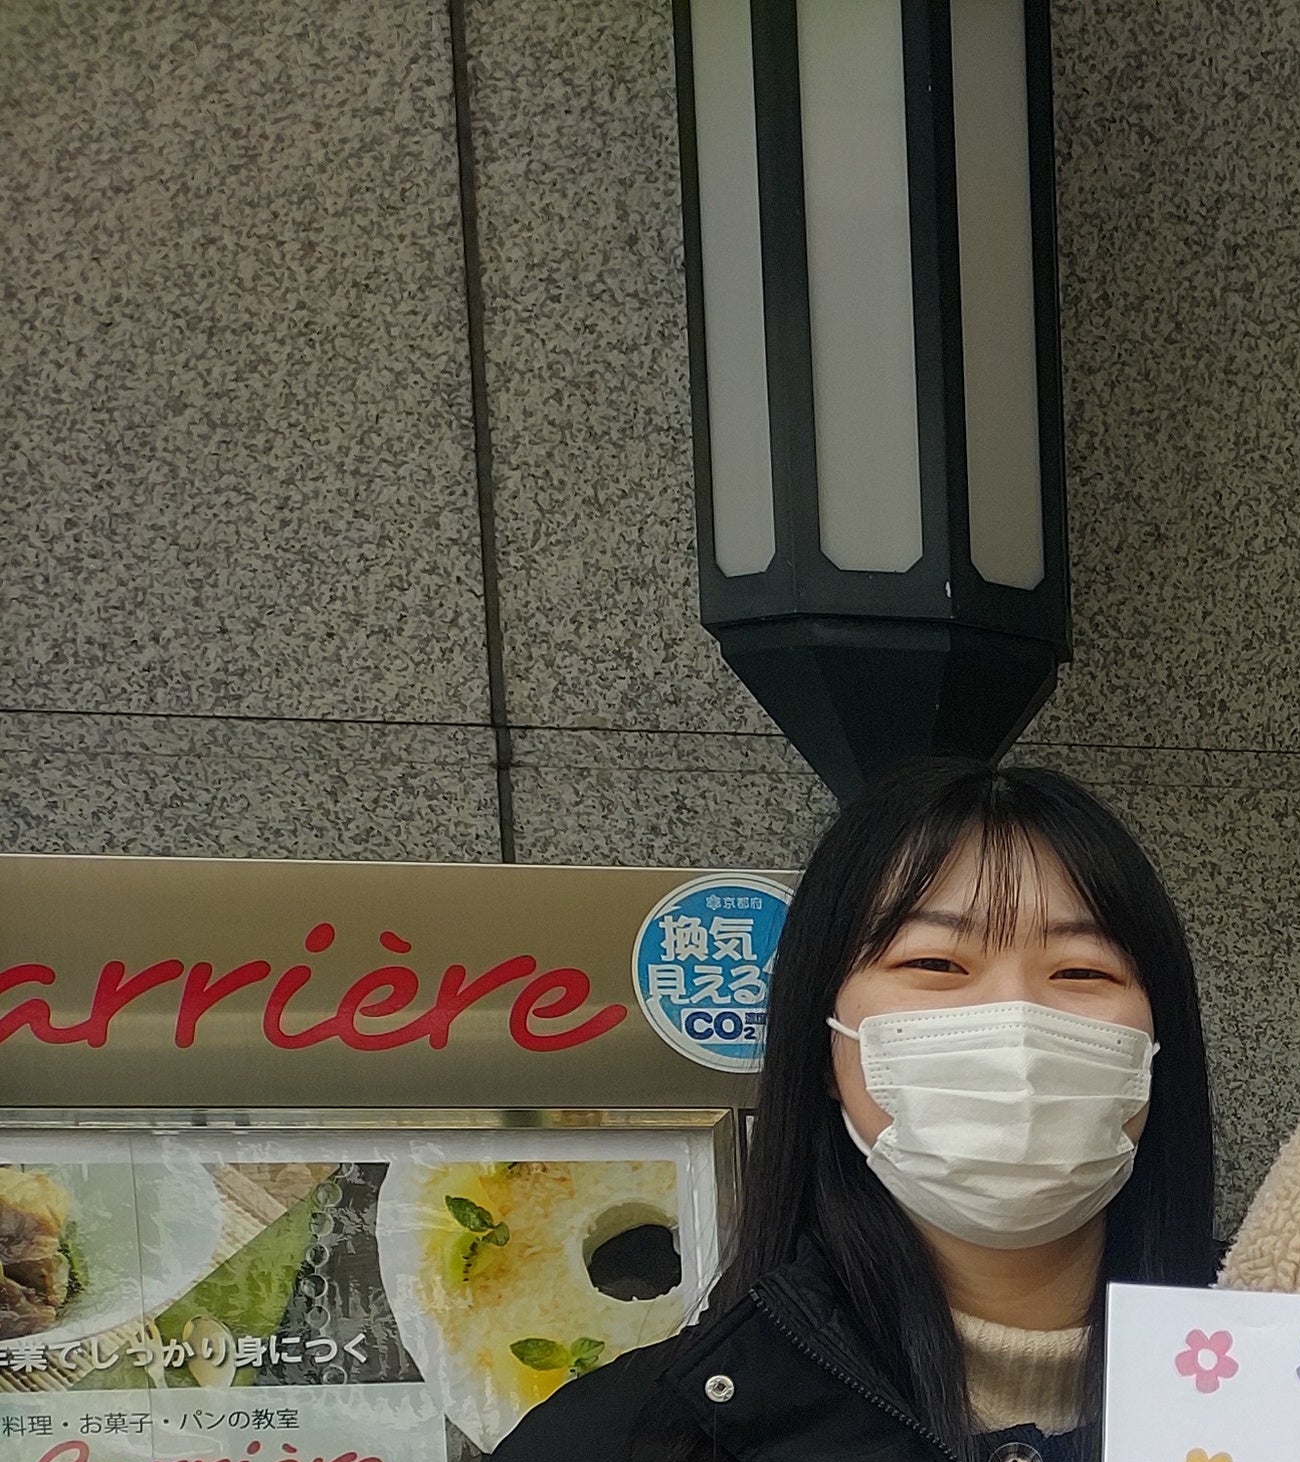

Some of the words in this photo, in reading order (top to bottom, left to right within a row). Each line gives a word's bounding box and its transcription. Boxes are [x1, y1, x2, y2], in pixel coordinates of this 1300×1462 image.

[723, 897, 762, 909] 京都府
[659, 915, 757, 961] 換気
[646, 964, 768, 1004] 見える
